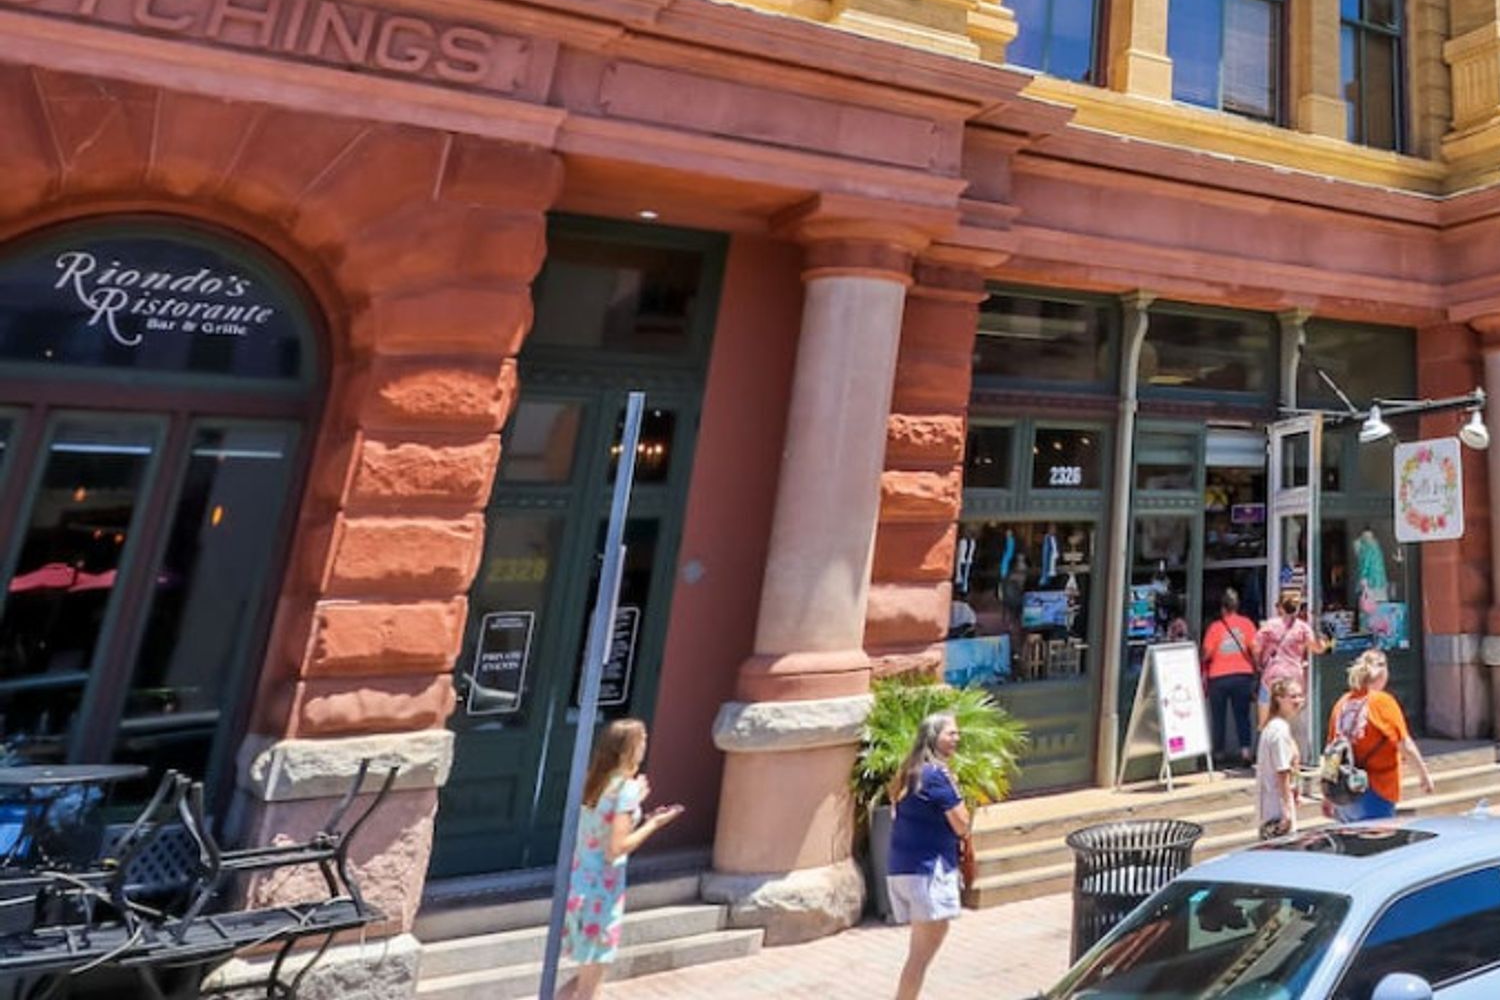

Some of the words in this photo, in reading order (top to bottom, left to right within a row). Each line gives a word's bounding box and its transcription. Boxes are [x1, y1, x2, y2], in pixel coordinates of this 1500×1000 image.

[55, 251, 250, 309] Riondo's
[88, 287, 274, 346] Ristorante
[146, 318, 176, 331] Bar
[1049, 466, 1082, 486] 2326
